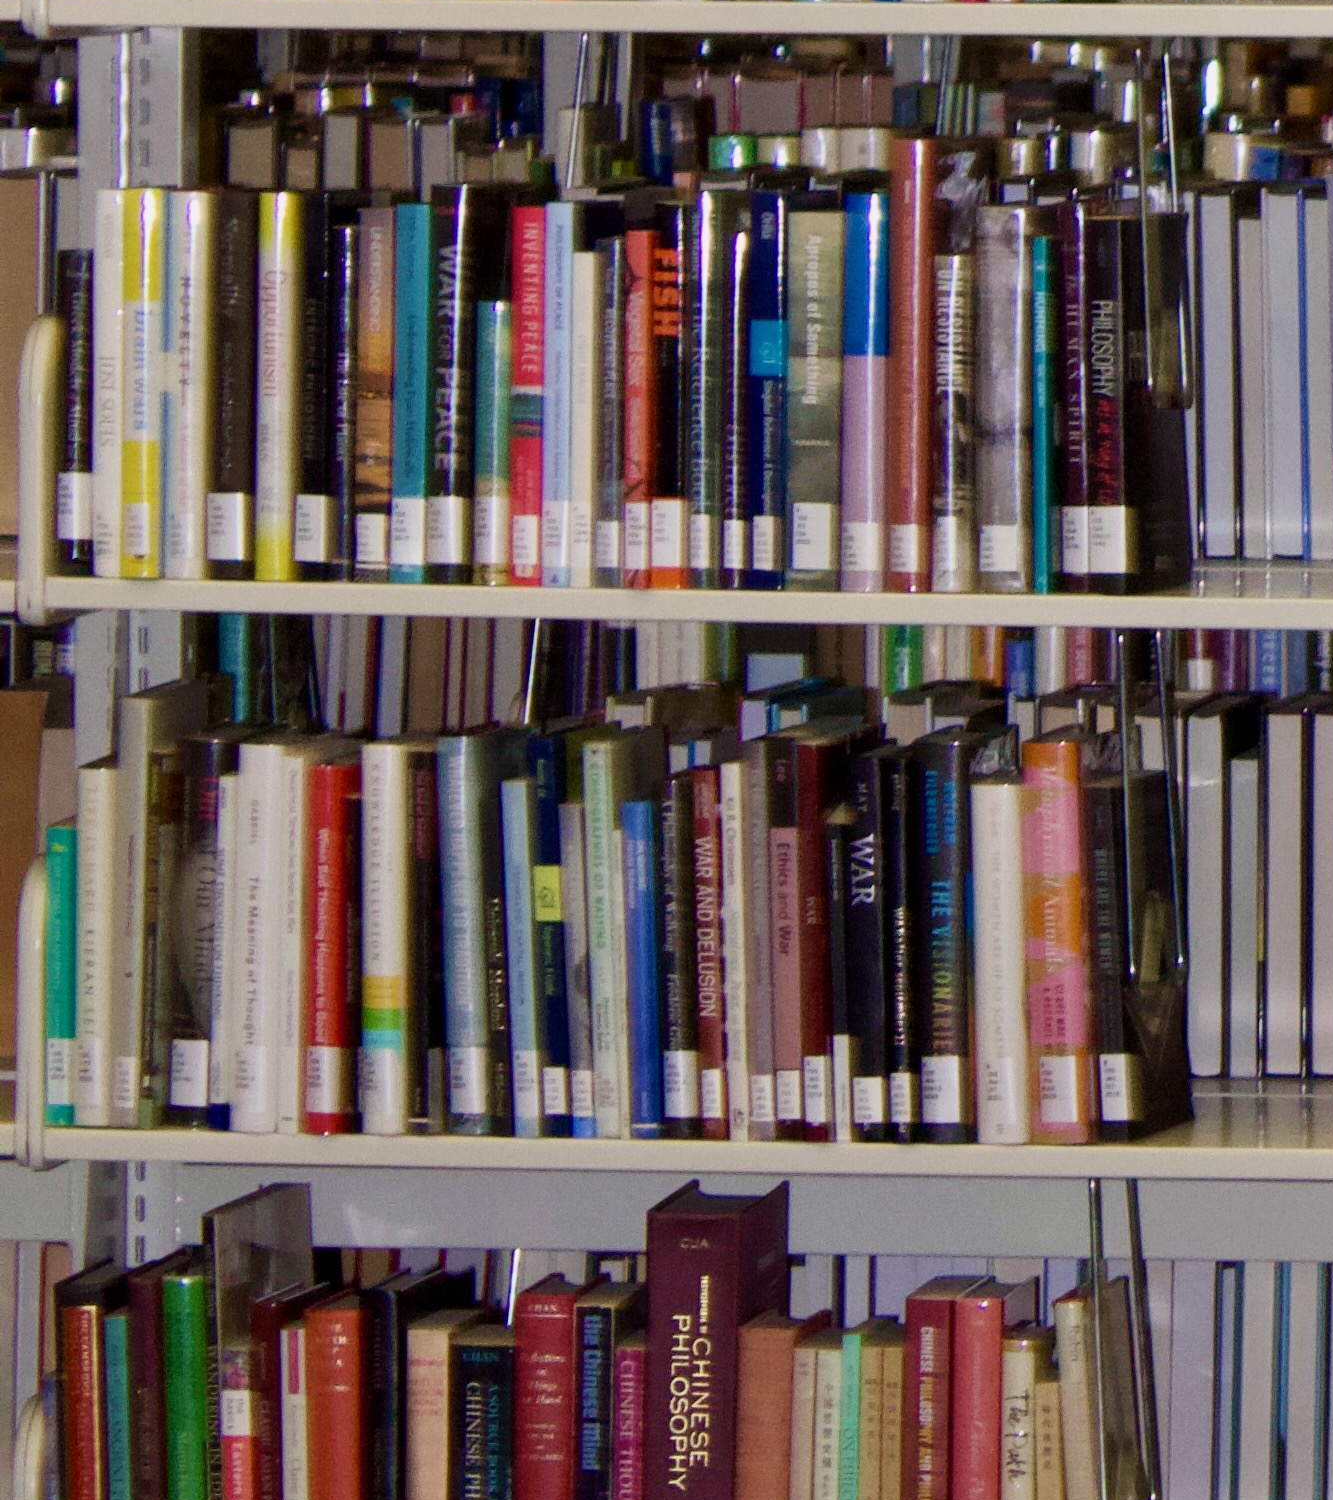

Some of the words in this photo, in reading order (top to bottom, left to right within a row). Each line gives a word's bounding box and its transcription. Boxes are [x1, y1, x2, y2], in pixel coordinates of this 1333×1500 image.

[368, 227, 383, 332] UNDERSTANDING
[437, 243, 460, 319] WAR
[521, 222, 540, 316] INVENTING
[652, 248, 679, 337] FISH
[803, 235, 819, 298] Apropos
[260, 269, 288, 398] Opportunism
[628, 290, 645, 353] Vegetal
[805, 304, 819, 320] of
[133, 309, 153, 374] brain
[437, 324, 455, 360] FOR
[521, 321, 538, 373] PEACE
[801, 323, 819, 405] Something
[1091, 300, 1113, 397] PHILOSOPHY
[98, 356, 116, 393] LOST
[628, 356, 645, 385] Sex
[98, 395, 114, 447] SOULS
[133, 377, 149, 430] wars
[434, 367, 458, 471] PEACE
[316, 828, 329, 862] When
[695, 836, 713, 879] WAR
[777, 842, 791, 887] Ethics
[850, 833, 875, 906] WAR
[247, 876, 259, 901] The
[316, 865, 329, 887] Bad
[315, 890, 329, 939] Thinking
[696, 884, 714, 922] AND
[777, 890, 790, 920] and
[244, 905, 258, 965] Meaning
[777, 925, 791, 956] War
[246, 970, 258, 984] of
[314, 943, 328, 994] Happens
[698, 927, 715, 1017] DELUSION
[243, 987, 257, 1045] Thought
[315, 996, 328, 1008] to
[315, 1011, 327, 1042] Good
[919, 1326, 932, 1373] CHINESE
[464, 1382, 481, 1466] CHINESE
[618, 1359, 634, 1440] CHINESE
[668, 1314, 689, 1490] PHILOSOPHY
[690, 1337, 710, 1467] CHINESE
[919, 1376, 932, 1445] PHILOSOPHY
[1005, 1389, 1030, 1428] The
[232, 1442, 245, 1498] Eastern
[919, 1448, 932, 1471] AND
[1007, 1432, 1028, 1485] Path
